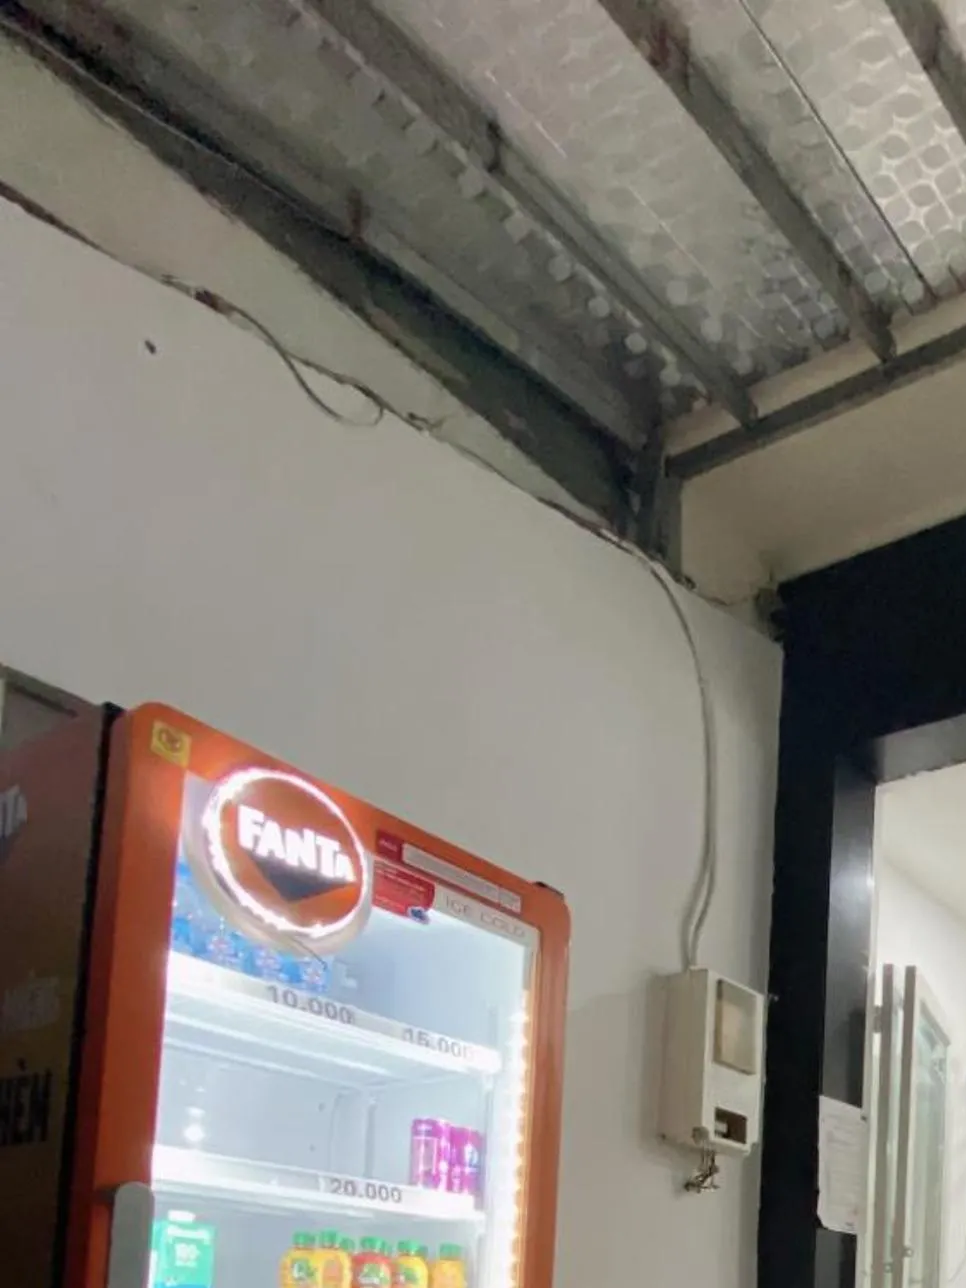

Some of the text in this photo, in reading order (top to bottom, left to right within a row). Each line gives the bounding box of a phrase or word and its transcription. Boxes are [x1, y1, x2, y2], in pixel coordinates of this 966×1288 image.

[237, 804, 357, 882] FANTA
[266, 985, 355, 1024] 10.000
[331, 1178, 402, 1203] 20.000
